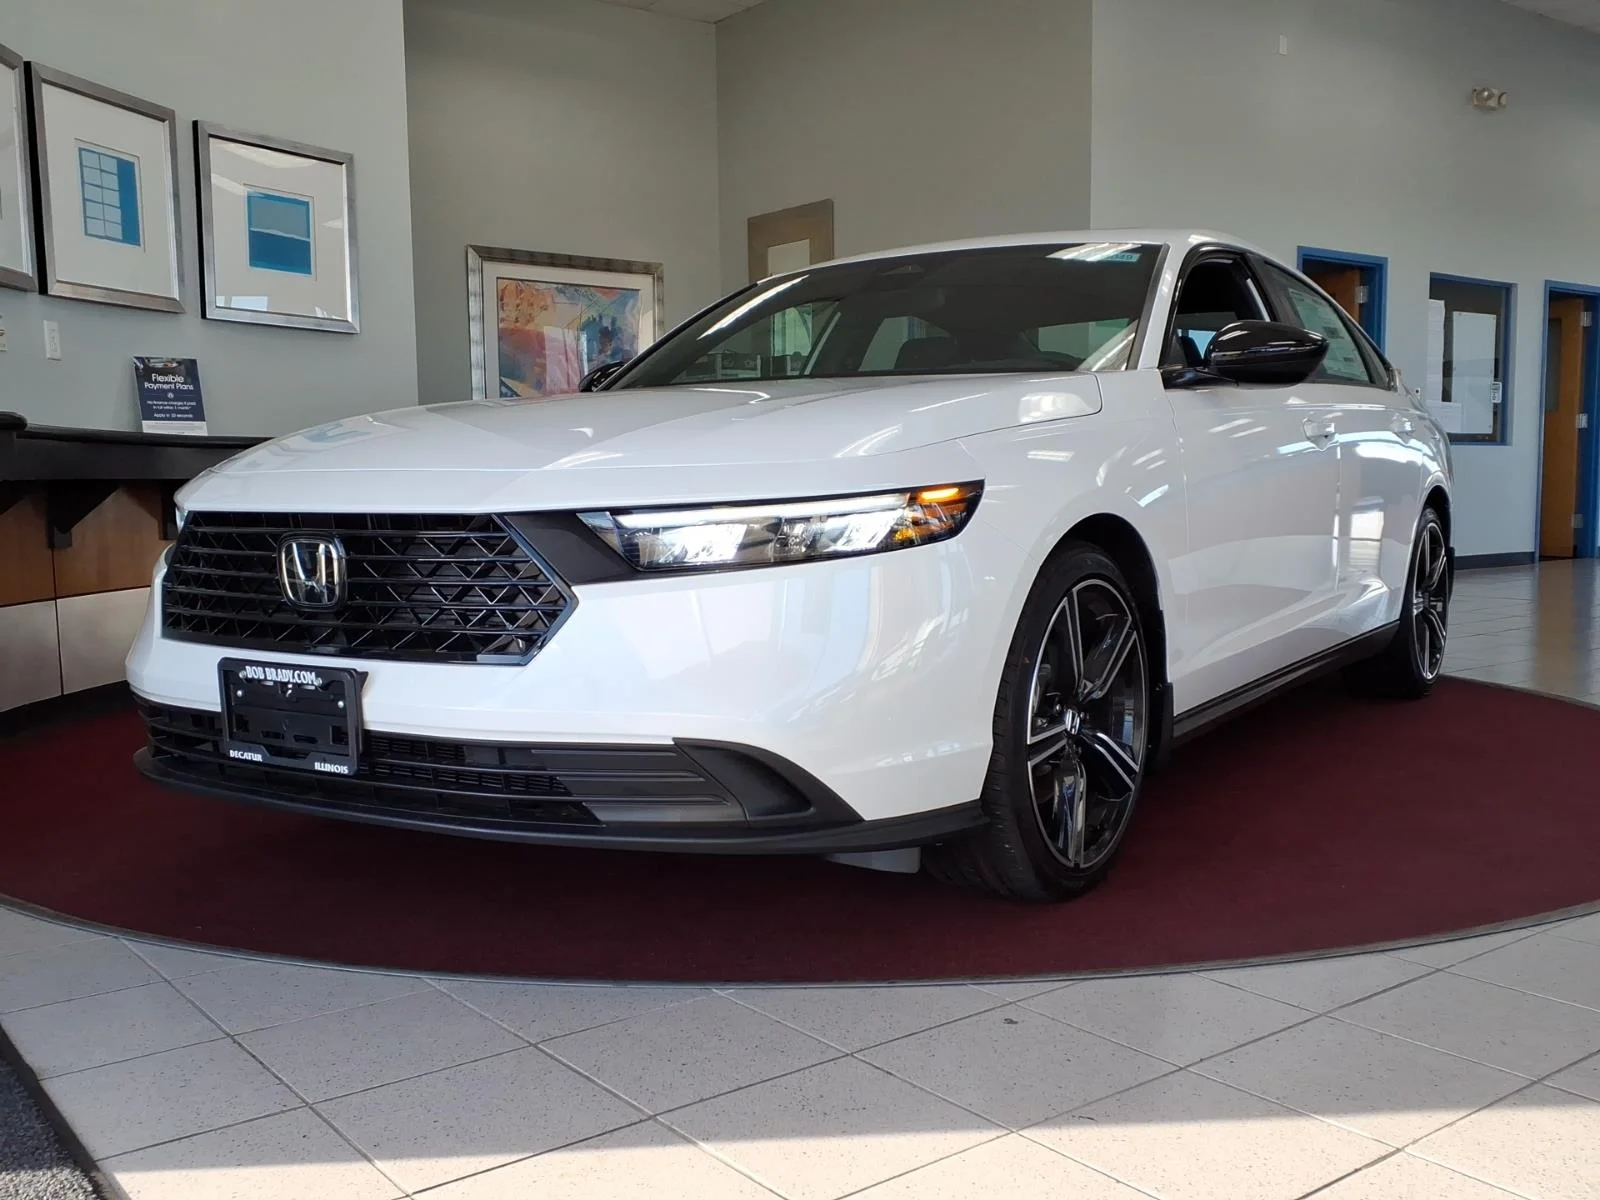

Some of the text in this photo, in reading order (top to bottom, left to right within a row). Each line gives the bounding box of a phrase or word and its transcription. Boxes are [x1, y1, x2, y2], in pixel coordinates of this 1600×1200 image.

[151, 373, 185, 383] Flexible
[144, 382, 175, 390] Payment
[245, 665, 316, 685] BOB BRADY.COM
[229, 749, 263, 762] DECATUR
[314, 762, 349, 774] ILLINOIS
